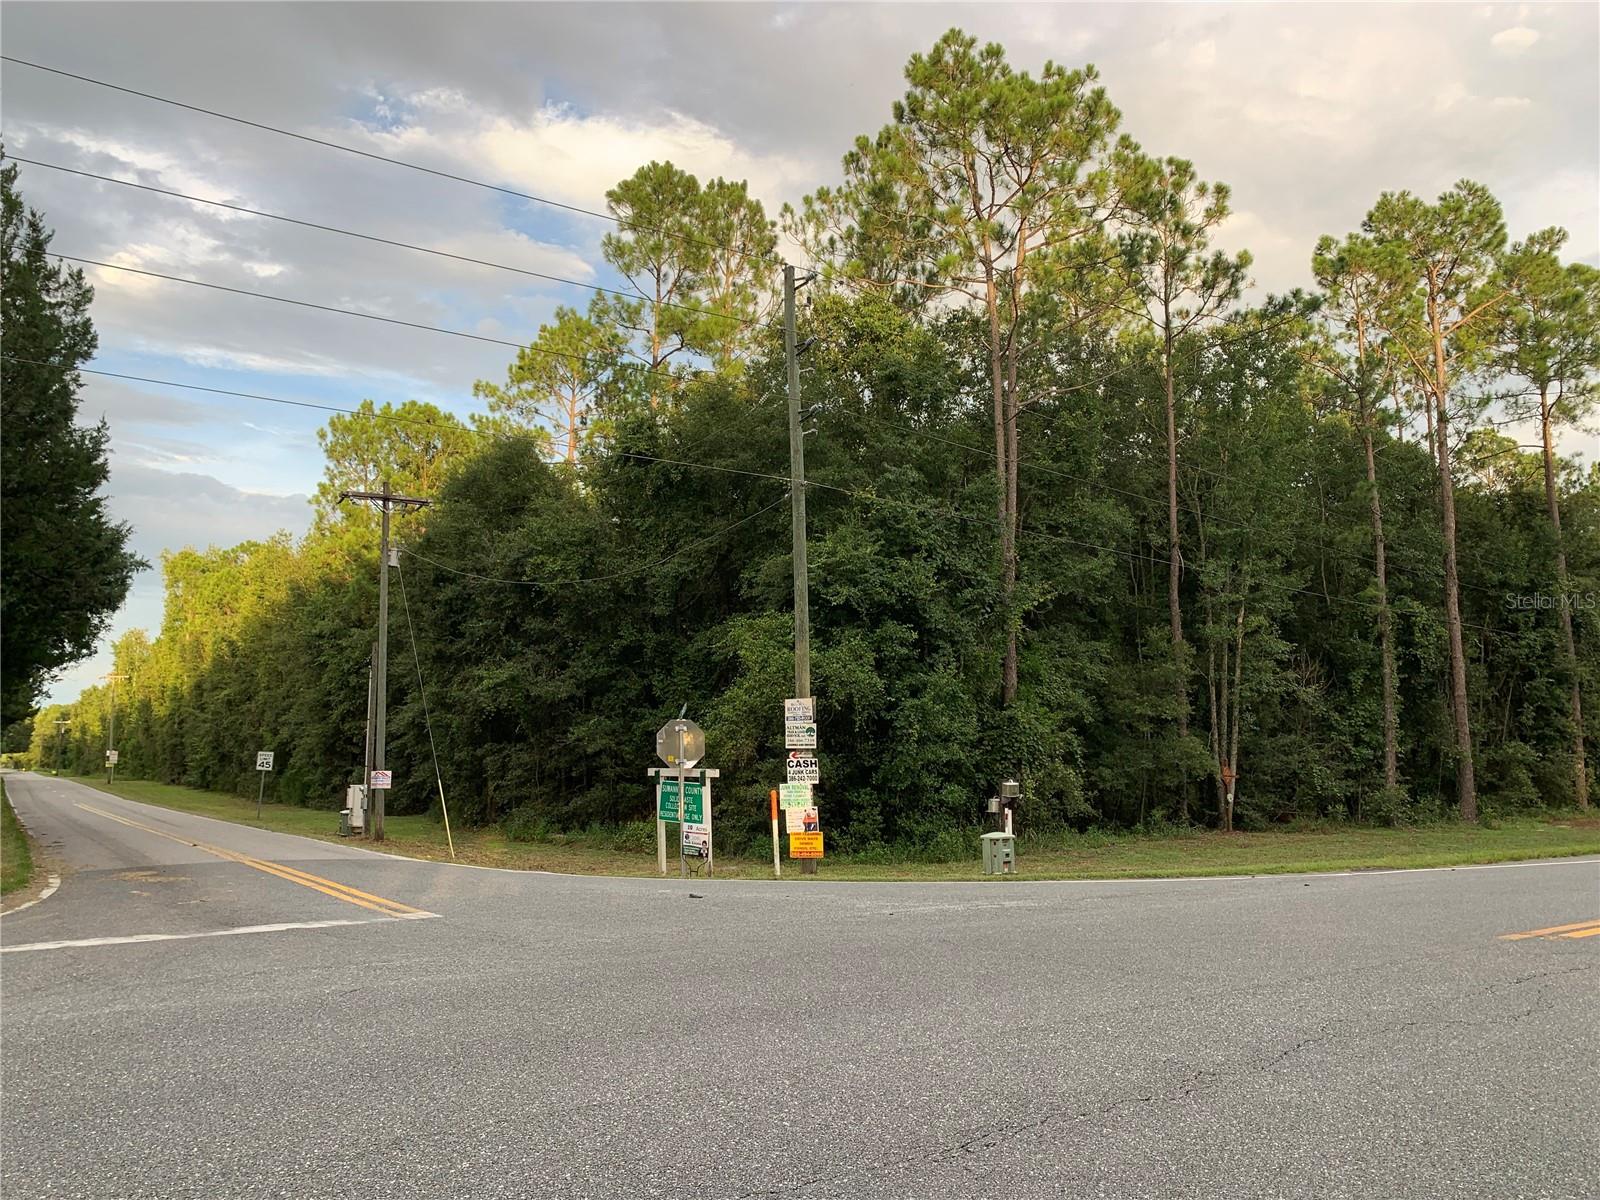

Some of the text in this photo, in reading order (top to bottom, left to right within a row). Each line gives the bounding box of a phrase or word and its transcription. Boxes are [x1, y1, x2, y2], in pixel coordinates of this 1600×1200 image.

[258, 761, 271, 769] 45
[788, 760, 817, 769] CASH
[685, 786, 702, 796] COUNTY
[688, 804, 697, 812] SITE
[691, 813, 703, 822] ONLY
